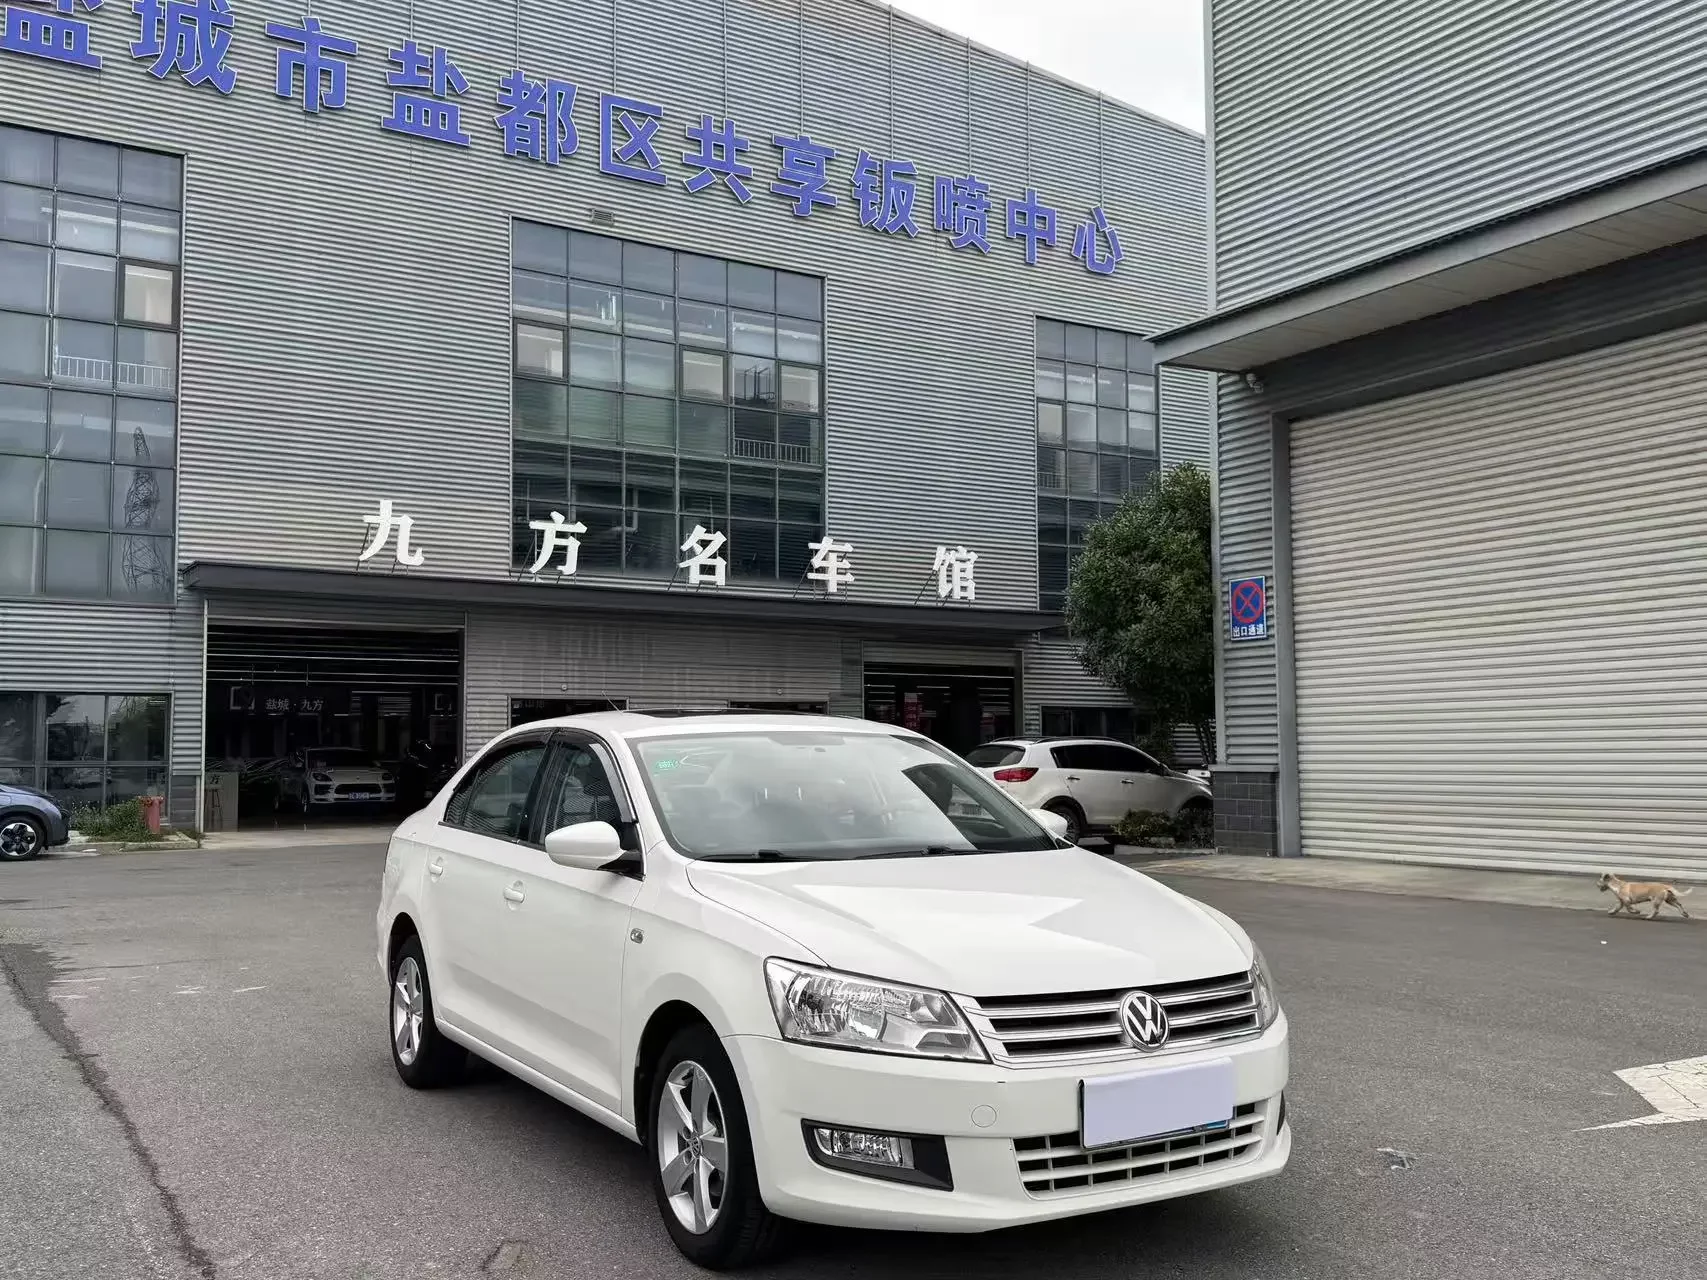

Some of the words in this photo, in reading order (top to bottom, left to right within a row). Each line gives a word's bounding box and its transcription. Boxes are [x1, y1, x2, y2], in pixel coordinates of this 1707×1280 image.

[358, 499, 977, 600] 九方名车馆
[1233, 623, 1264, 637] 出口通道
